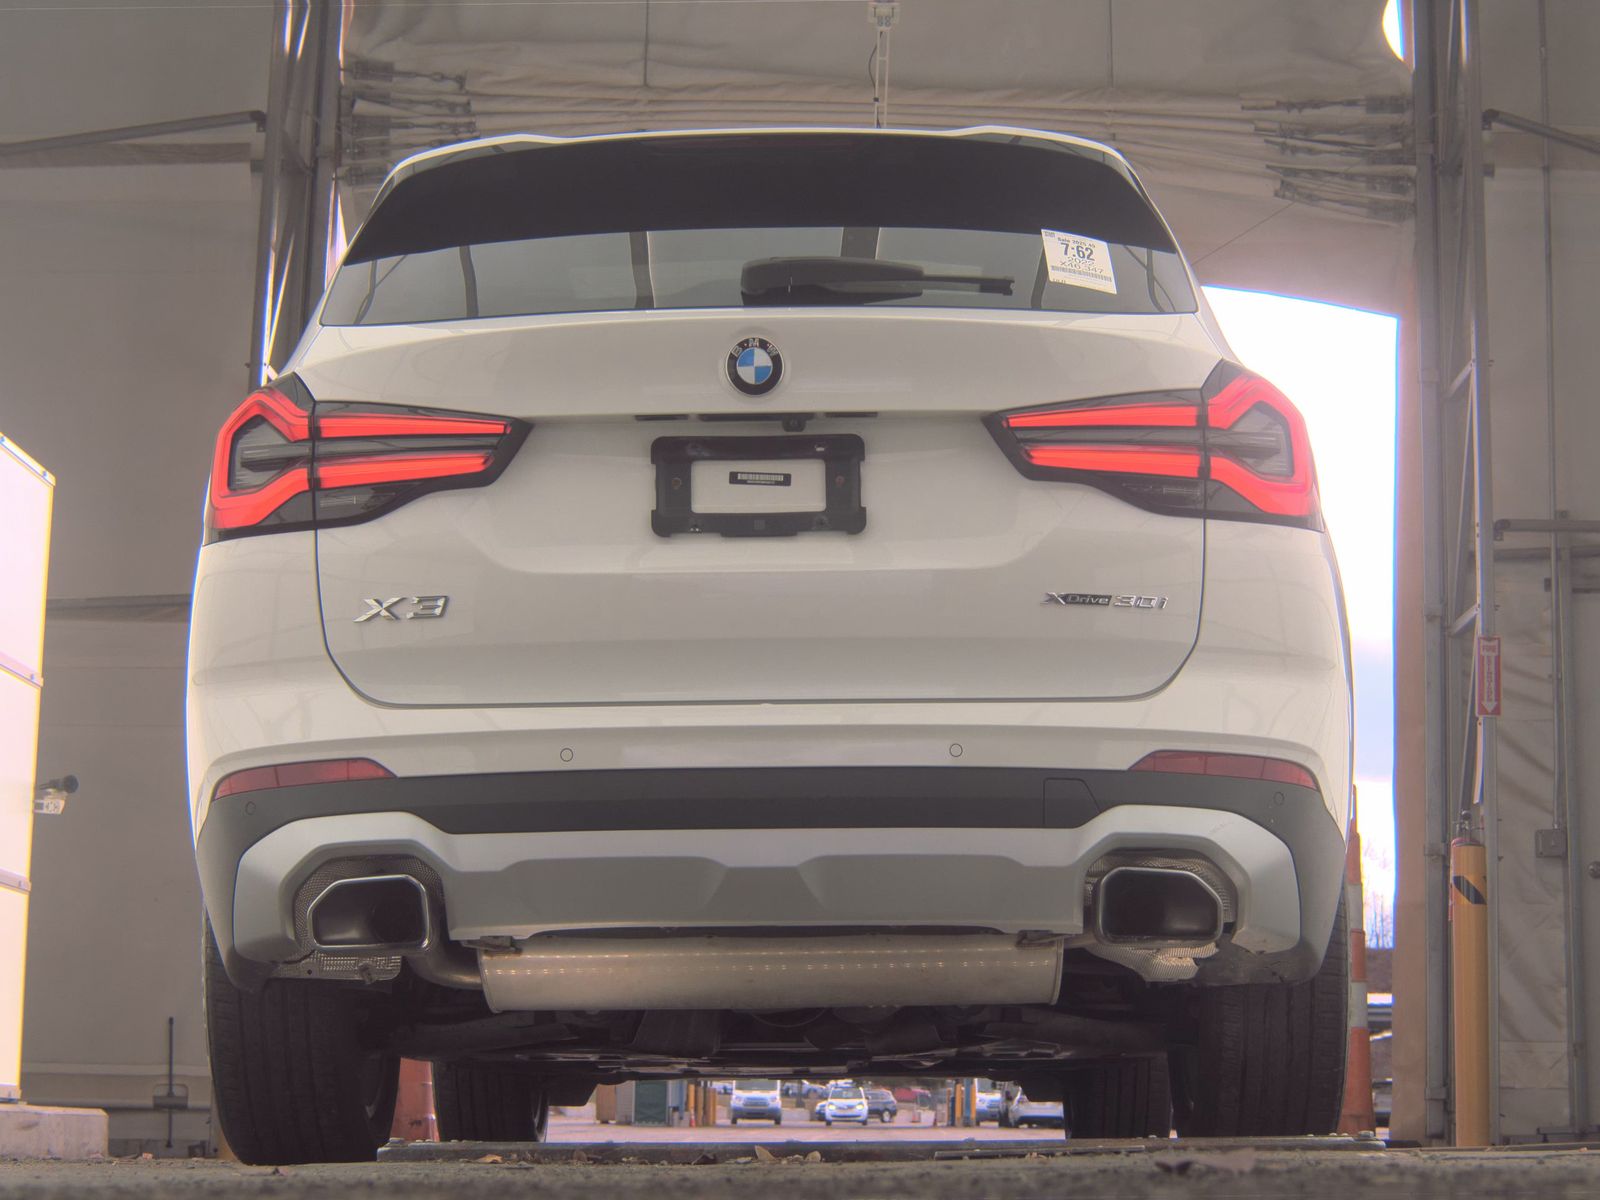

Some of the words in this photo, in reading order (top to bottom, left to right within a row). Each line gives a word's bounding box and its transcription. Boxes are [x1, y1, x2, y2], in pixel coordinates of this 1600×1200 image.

[1060, 242, 1095, 262] 7:62
[730, 337, 779, 358] BMW
[352, 595, 450, 623] X3
